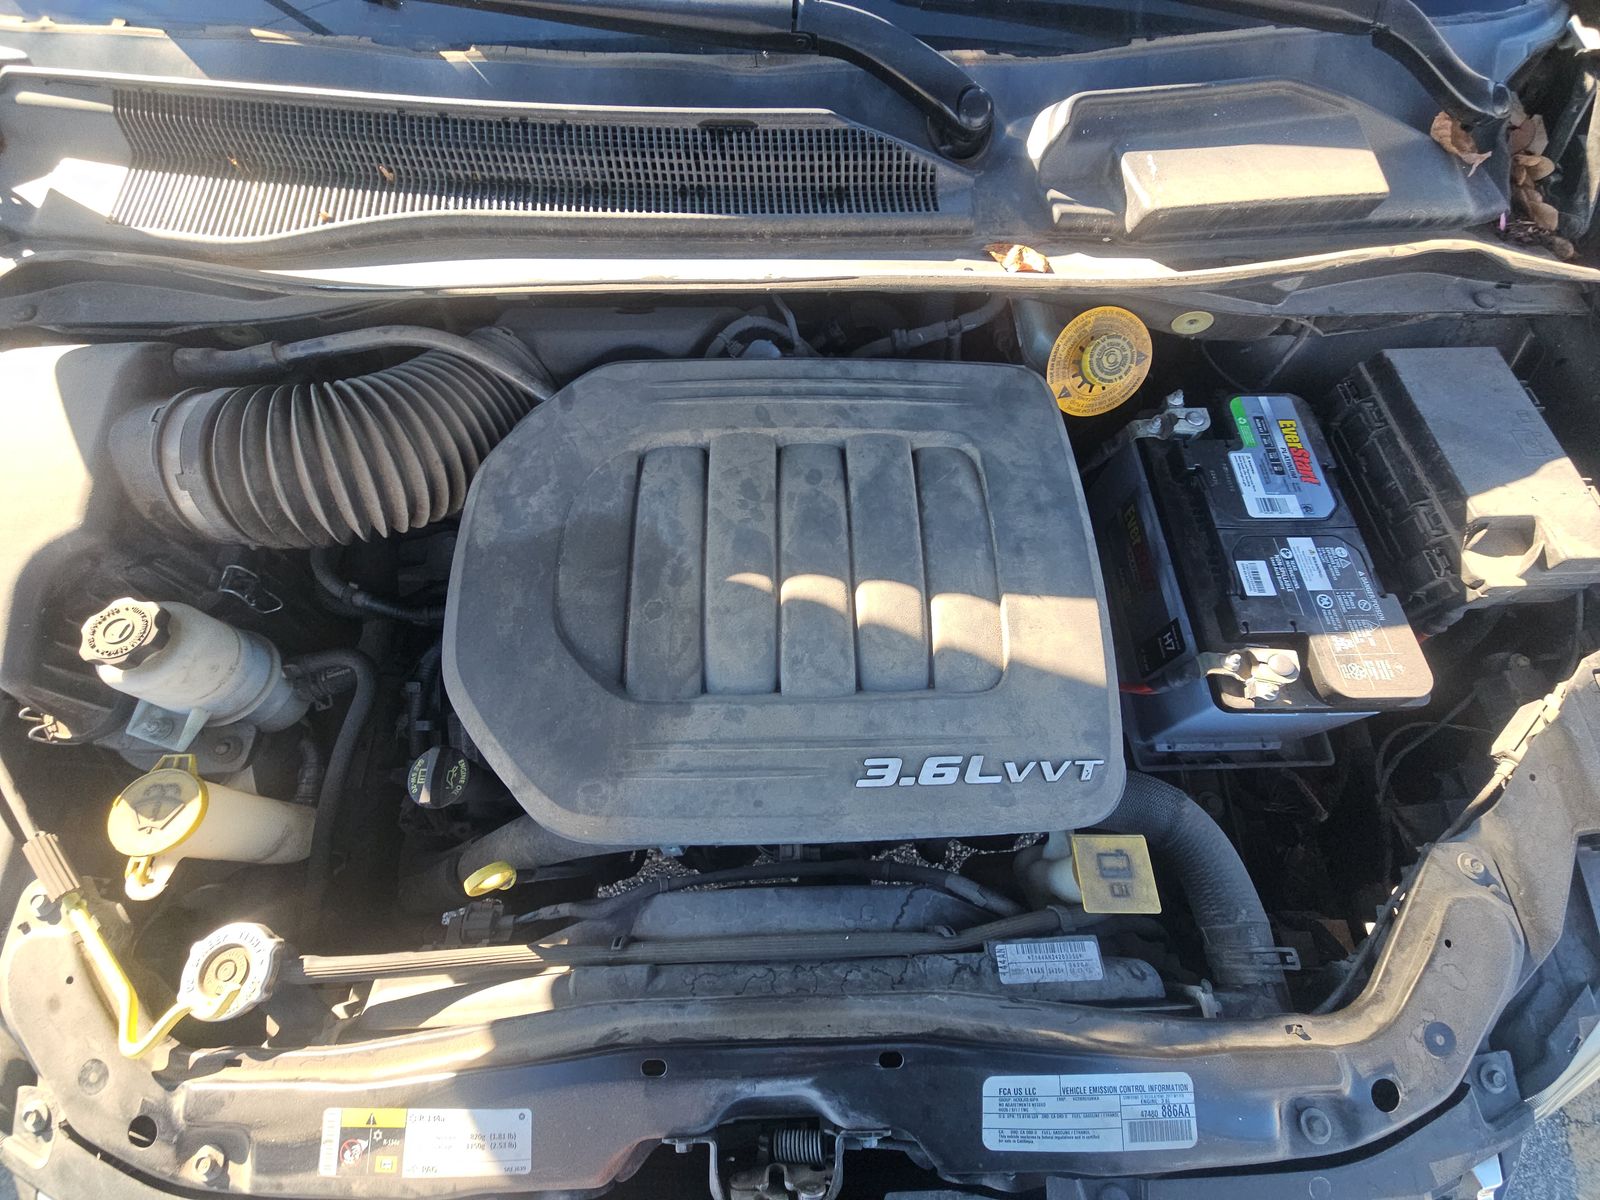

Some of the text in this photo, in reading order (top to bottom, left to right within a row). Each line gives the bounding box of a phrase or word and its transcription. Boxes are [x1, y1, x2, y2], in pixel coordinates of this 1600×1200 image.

[1280, 448, 1298, 478] PLATINUM
[1162, 631, 1176, 650] H7
[458, 759, 466, 784] ENGINE
[855, 755, 1104, 788] 3.6L VVT
[998, 1088, 1012, 1096] FCA
[1062, 1083, 1189, 1094] VEHICLE EMISSION CONTROL INFORMATION
[1161, 1106, 1190, 1118] 886AA
